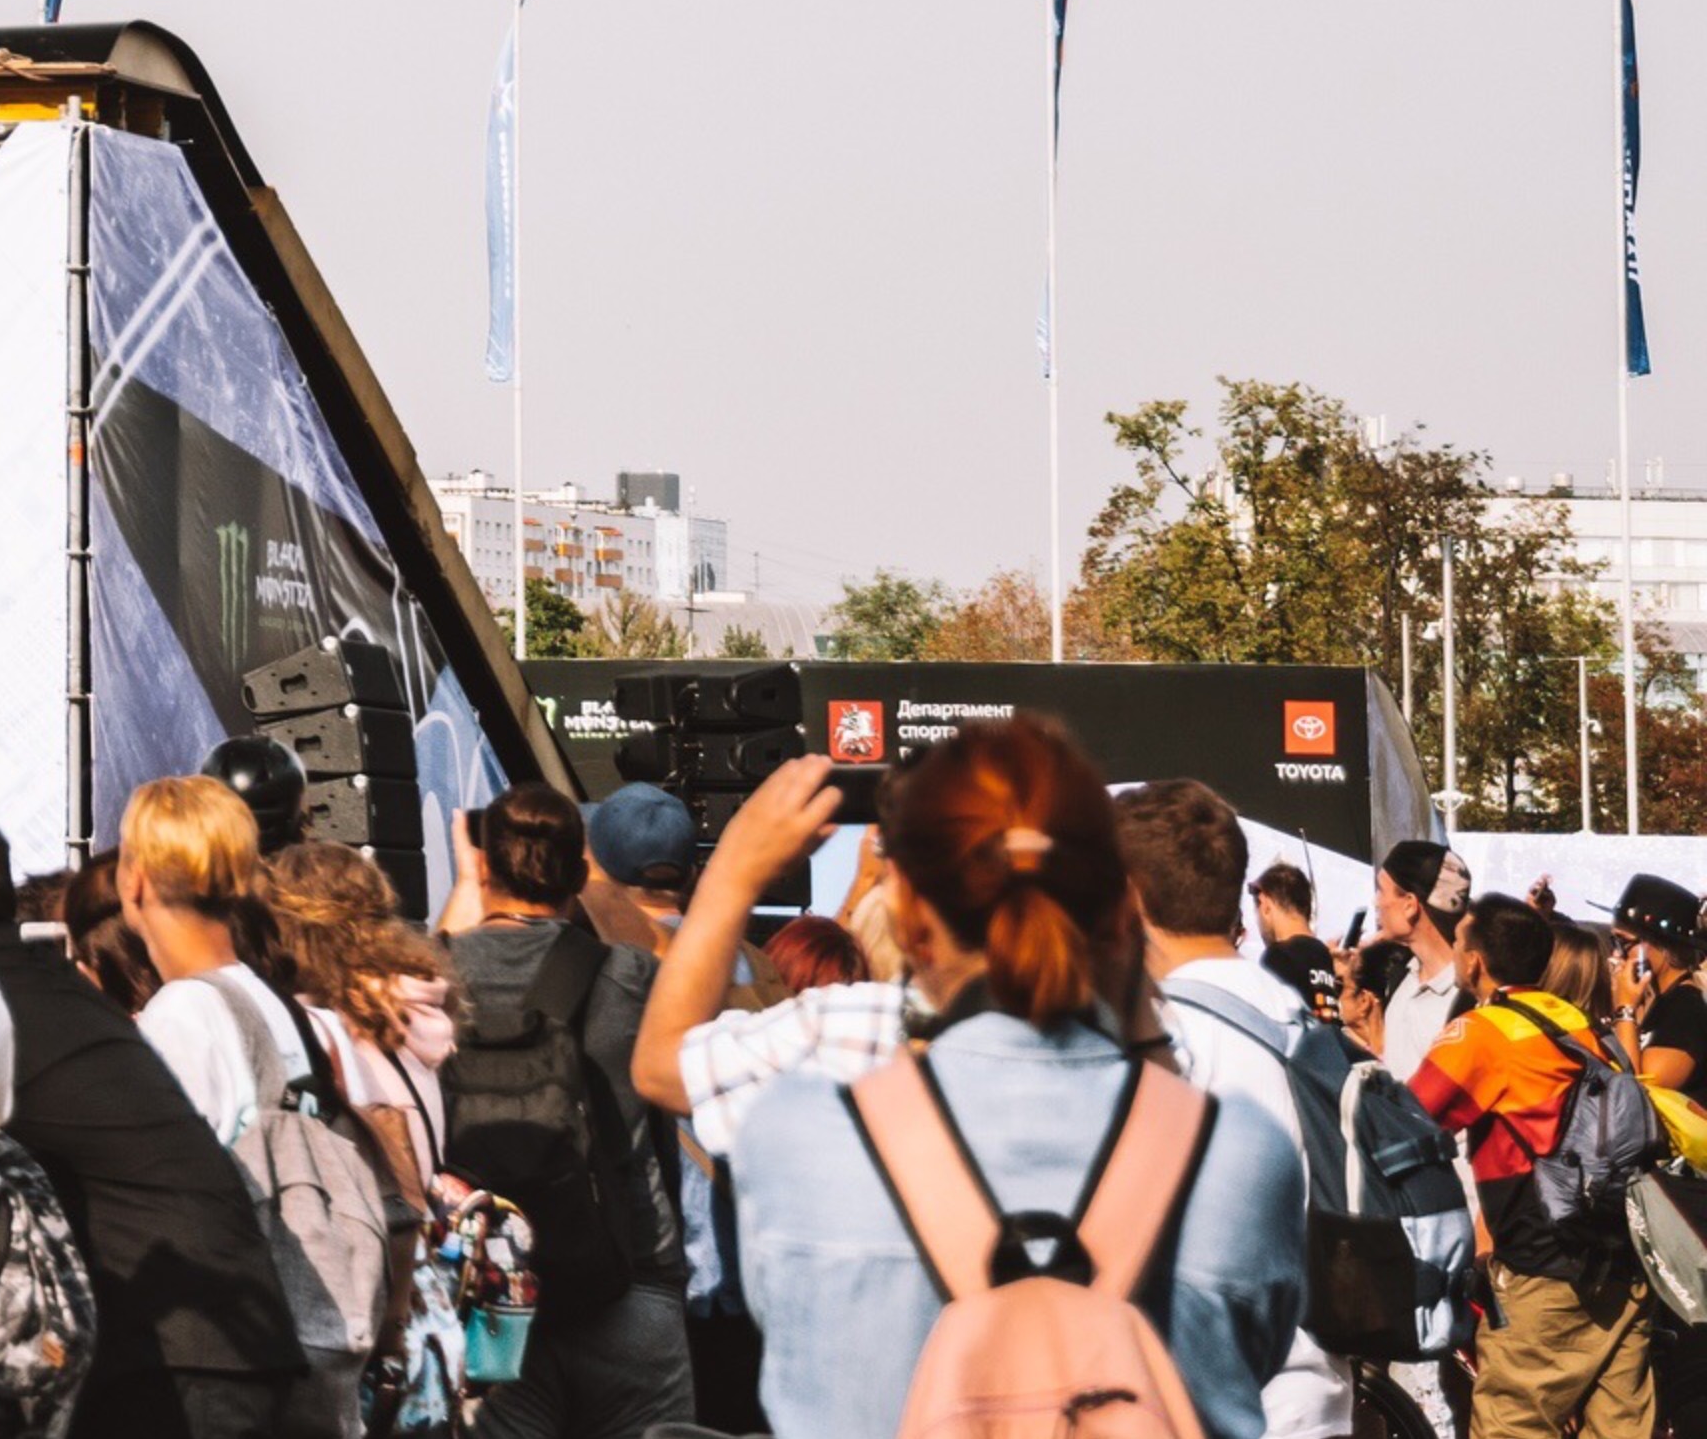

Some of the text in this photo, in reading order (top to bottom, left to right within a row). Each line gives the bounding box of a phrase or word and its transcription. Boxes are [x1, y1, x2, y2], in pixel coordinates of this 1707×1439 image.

[581, 700, 616, 715] BLA
[896, 699, 1014, 721] Департамент
[1274, 763, 1346, 781] TOYOTA
